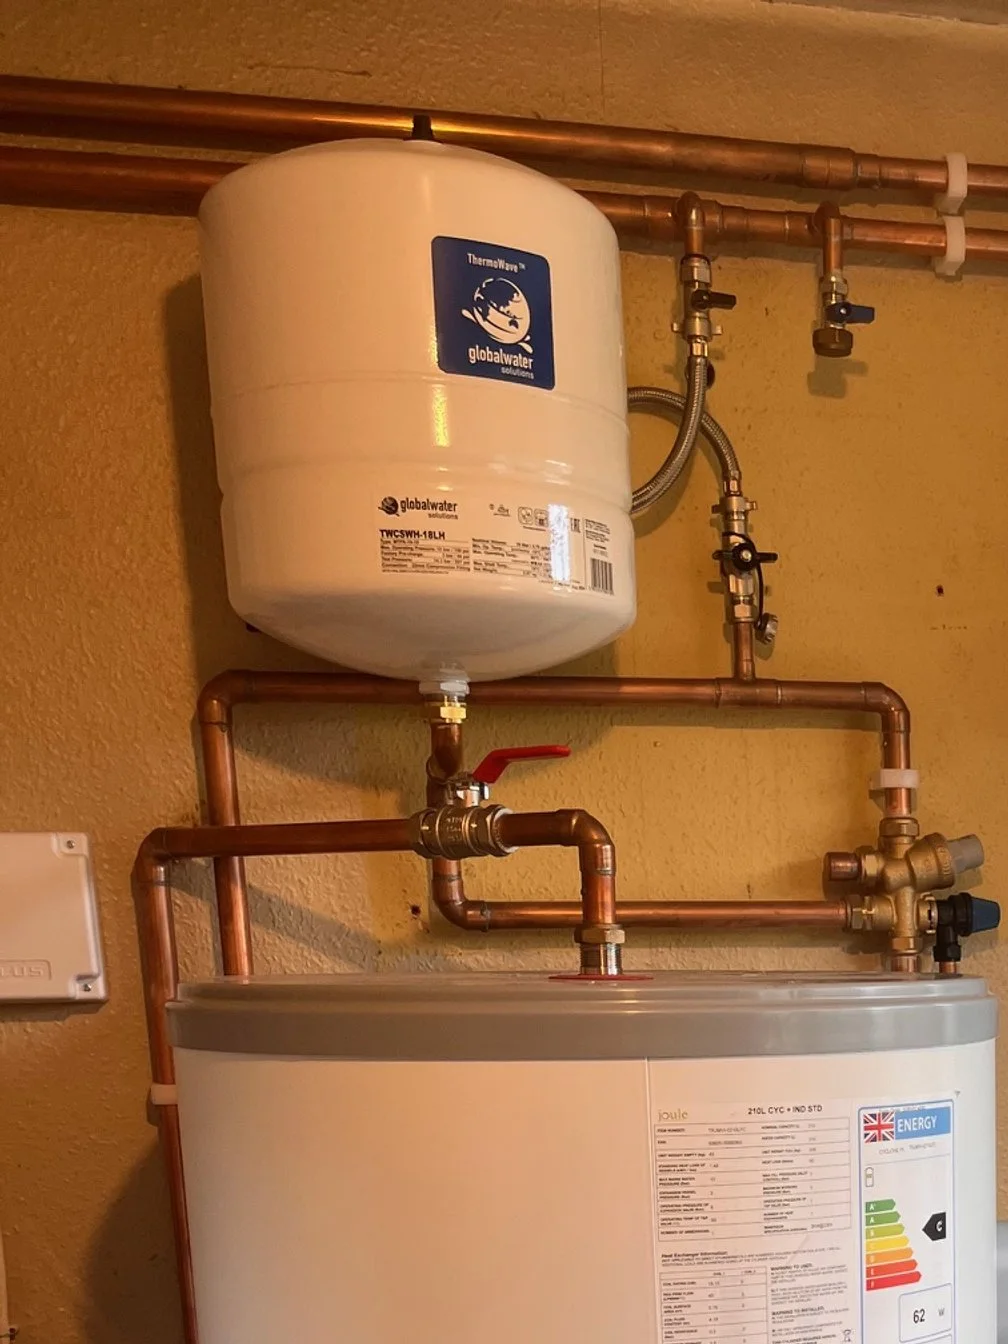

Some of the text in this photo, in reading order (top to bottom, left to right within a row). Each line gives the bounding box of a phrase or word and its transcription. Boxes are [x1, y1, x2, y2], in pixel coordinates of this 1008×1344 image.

[468, 344, 534, 369] globalwater
[501, 366, 534, 379] solutions
[400, 497, 458, 513] globalwater
[428, 512, 458, 520] solutions
[658, 1108, 688, 1121] joule
[748, 1106, 766, 1115] 210L
[768, 1106, 785, 1114] CYC
[793, 1105, 806, 1113] IND
[807, 1104, 823, 1112] STD
[897, 1115, 938, 1133] ENERGY
[935, 1219, 943, 1232] C
[913, 1307, 945, 1324] 62 W
